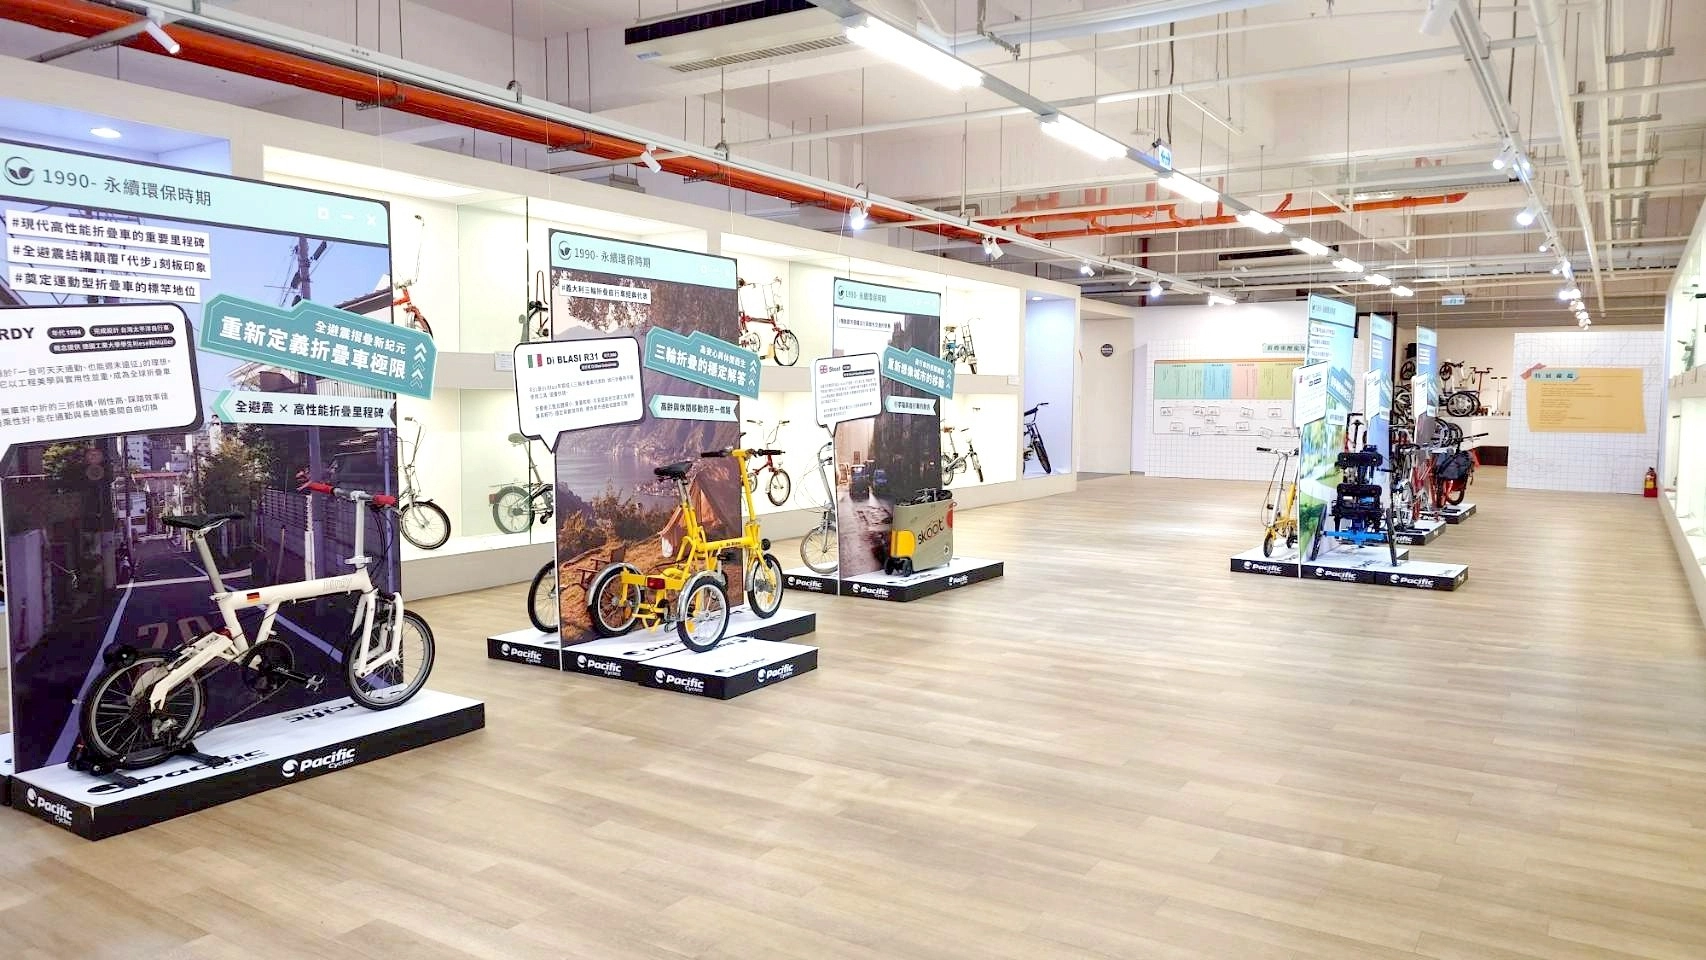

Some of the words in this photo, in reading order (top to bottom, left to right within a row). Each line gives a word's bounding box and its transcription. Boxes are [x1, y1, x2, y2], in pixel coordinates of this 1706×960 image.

[42, 168, 97, 189] 1990-
[104, 176, 213, 207] 永續環保時期
[11, 217, 205, 248] #現代高性能折疊車的重要里程碑
[13, 245, 207, 273] #全避震結構顛覆「代步」刻板印象
[601, 250, 651, 269] 永續環保時期
[15, 272, 196, 298] #奠定運動型折疊車的標竿地位
[315, 319, 406, 356] 全避震摺疊新紀元
[219, 315, 406, 379] 重新定義折疊車極限
[557, 354, 582, 364] BLASI
[584, 352, 599, 362] R31
[235, 400, 274, 414] 全避震
[293, 403, 384, 419] 高性能折疊里程碑
[1252, 563, 1283, 572] Pacific
[1325, 570, 1357, 579] Pacific
[796, 579, 823, 589] Pacific
[1400, 577, 1434, 586] Pacific
[861, 586, 890, 597] Pacific
[511, 647, 542, 660] Pacific
[588, 659, 622, 673] Pacific
[766, 664, 794, 680] Pacific
[666, 674, 704, 689] Pacific
[300, 748, 356, 772] Pacific
[37, 796, 73, 820] Pacific
